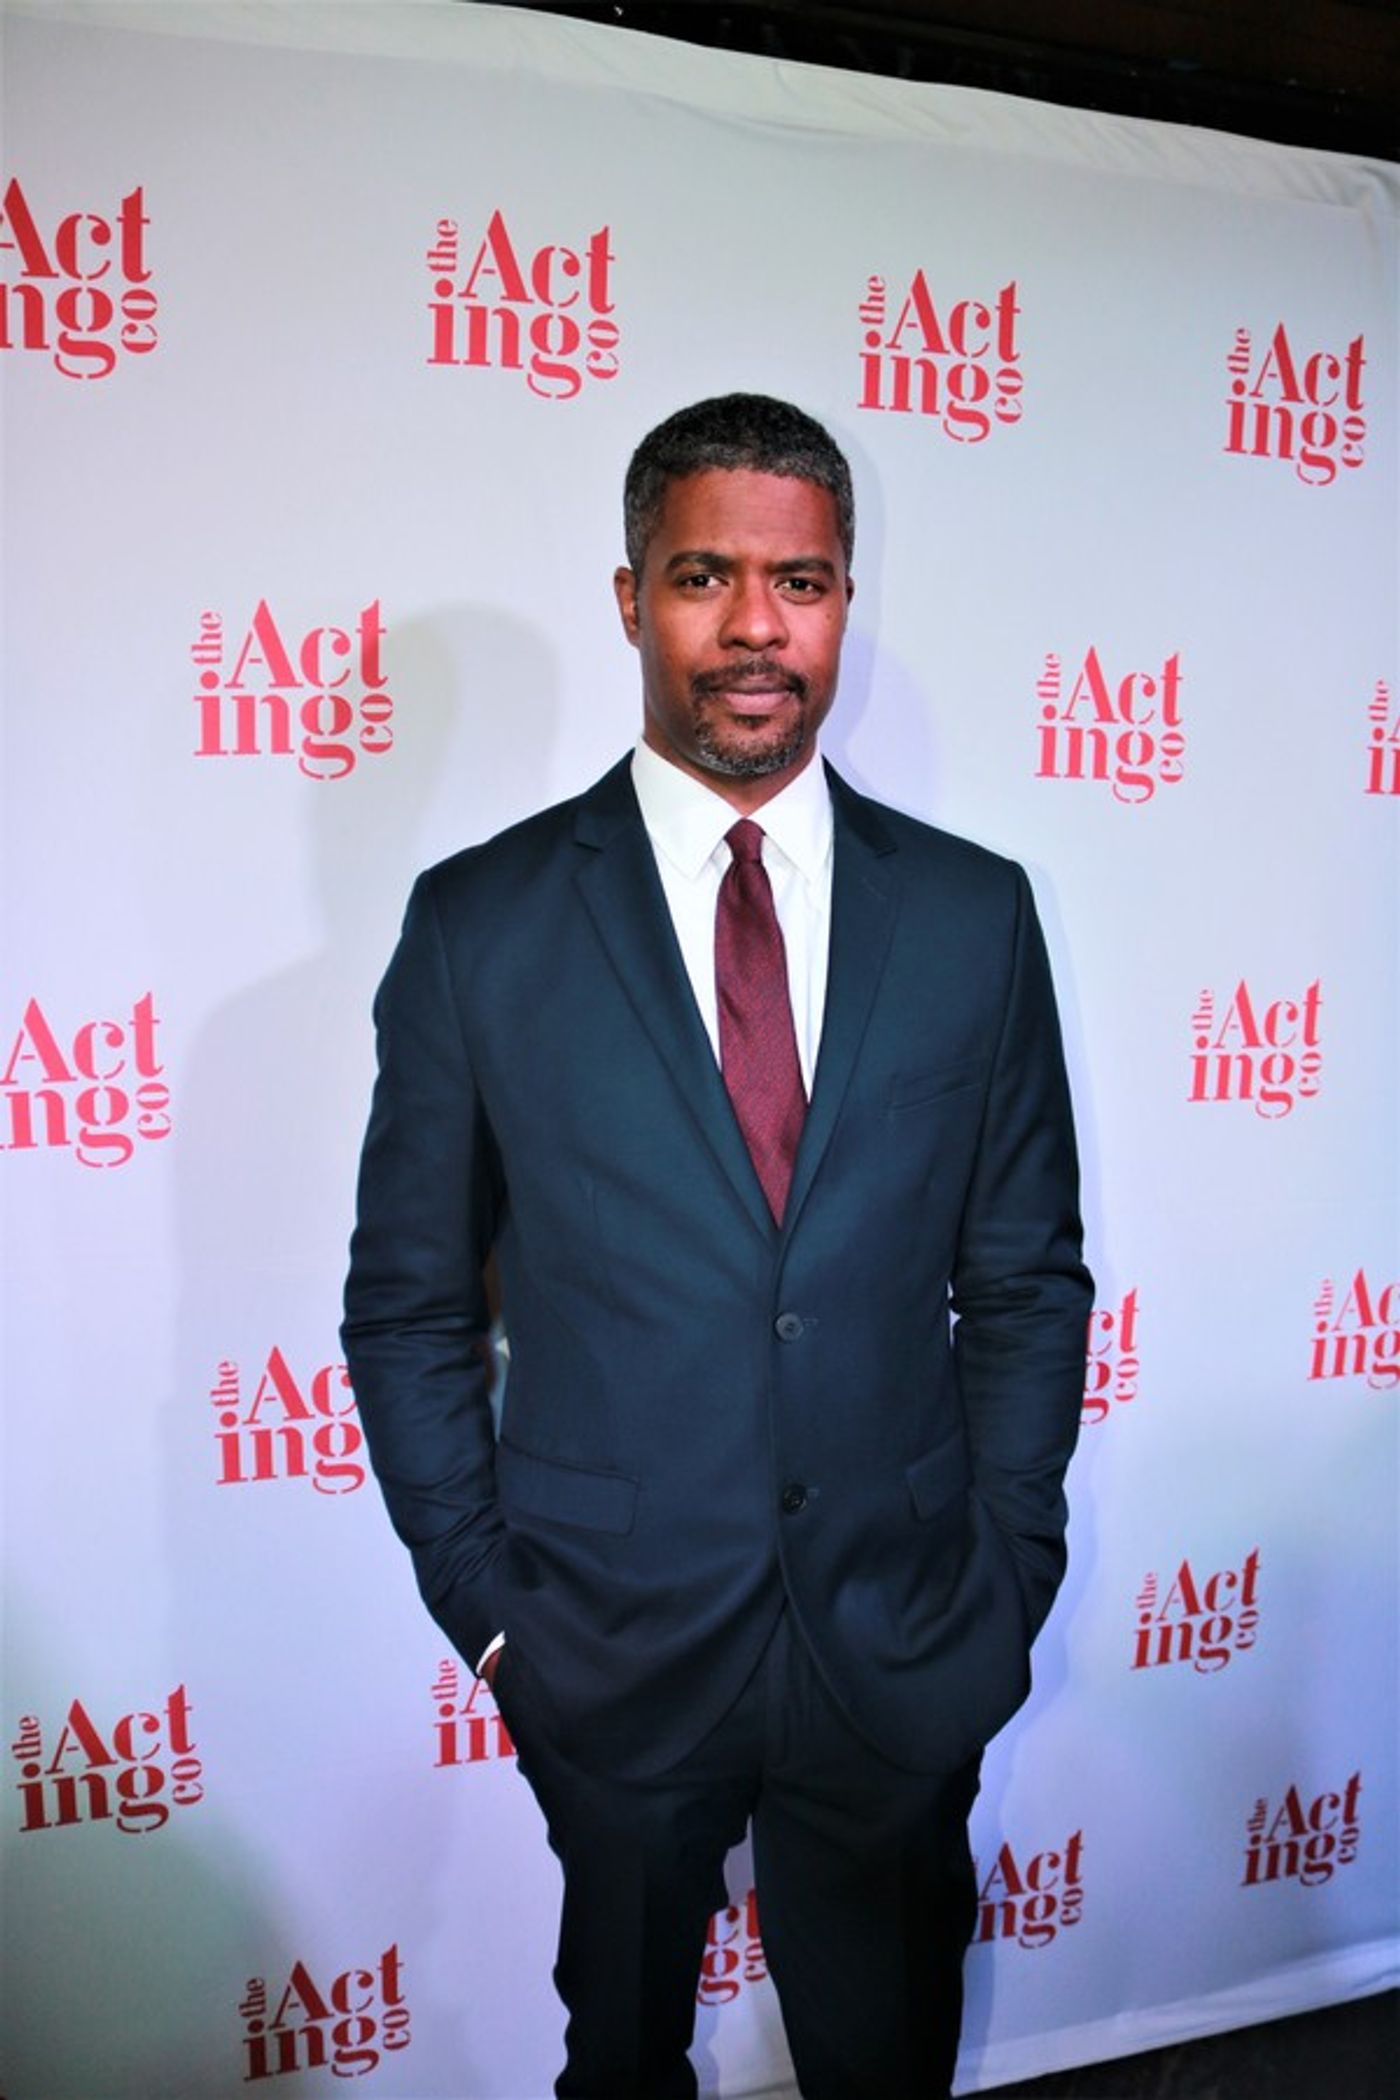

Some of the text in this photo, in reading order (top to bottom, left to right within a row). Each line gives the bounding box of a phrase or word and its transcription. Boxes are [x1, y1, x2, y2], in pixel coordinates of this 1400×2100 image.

[0, 177, 152, 285] Act
[426, 208, 616, 315] the Act
[0, 282, 158, 381] ng co
[427, 278, 620, 400] ing co
[858, 268, 1021, 364] the Act
[857, 330, 1023, 443] ing co
[1227, 322, 1367, 412] the Act
[1223, 379, 1366, 486] ing co
[190, 598, 389, 690] the Act
[193, 670, 394, 781] ing co
[1036, 645, 1184, 727] the Act
[1369, 680, 1388, 722] the
[1034, 704, 1186, 804] ing co
[0, 991, 164, 1085] Act
[1191, 978, 1323, 1048] the Act
[1187, 1035, 1323, 1119] ing co
[0, 1082, 172, 1168] ng co
[1085, 1286, 1140, 1357] ct
[1314, 1267, 1400, 1332] the Ac
[210, 1345, 357, 1425] the Ac
[1114, 1358, 1140, 1402] co
[215, 1412, 366, 1495] ing
[1137, 1547, 1261, 1622] the Act
[431, 1659, 458, 1702] the
[1130, 1610, 1260, 1673] ing co
[12, 1684, 197, 1775] the Act
[432, 1702, 519, 1768] in
[16, 1758, 205, 1833] ing co
[1247, 1771, 1362, 1844] the Act
[979, 1829, 1084, 1902] Act
[1240, 1825, 1361, 1887] ing co
[706, 1888, 760, 1948] ct
[974, 1888, 1084, 1950] ng co
[239, 1943, 406, 2030] the Act
[242, 2007, 411, 2082] ing co
